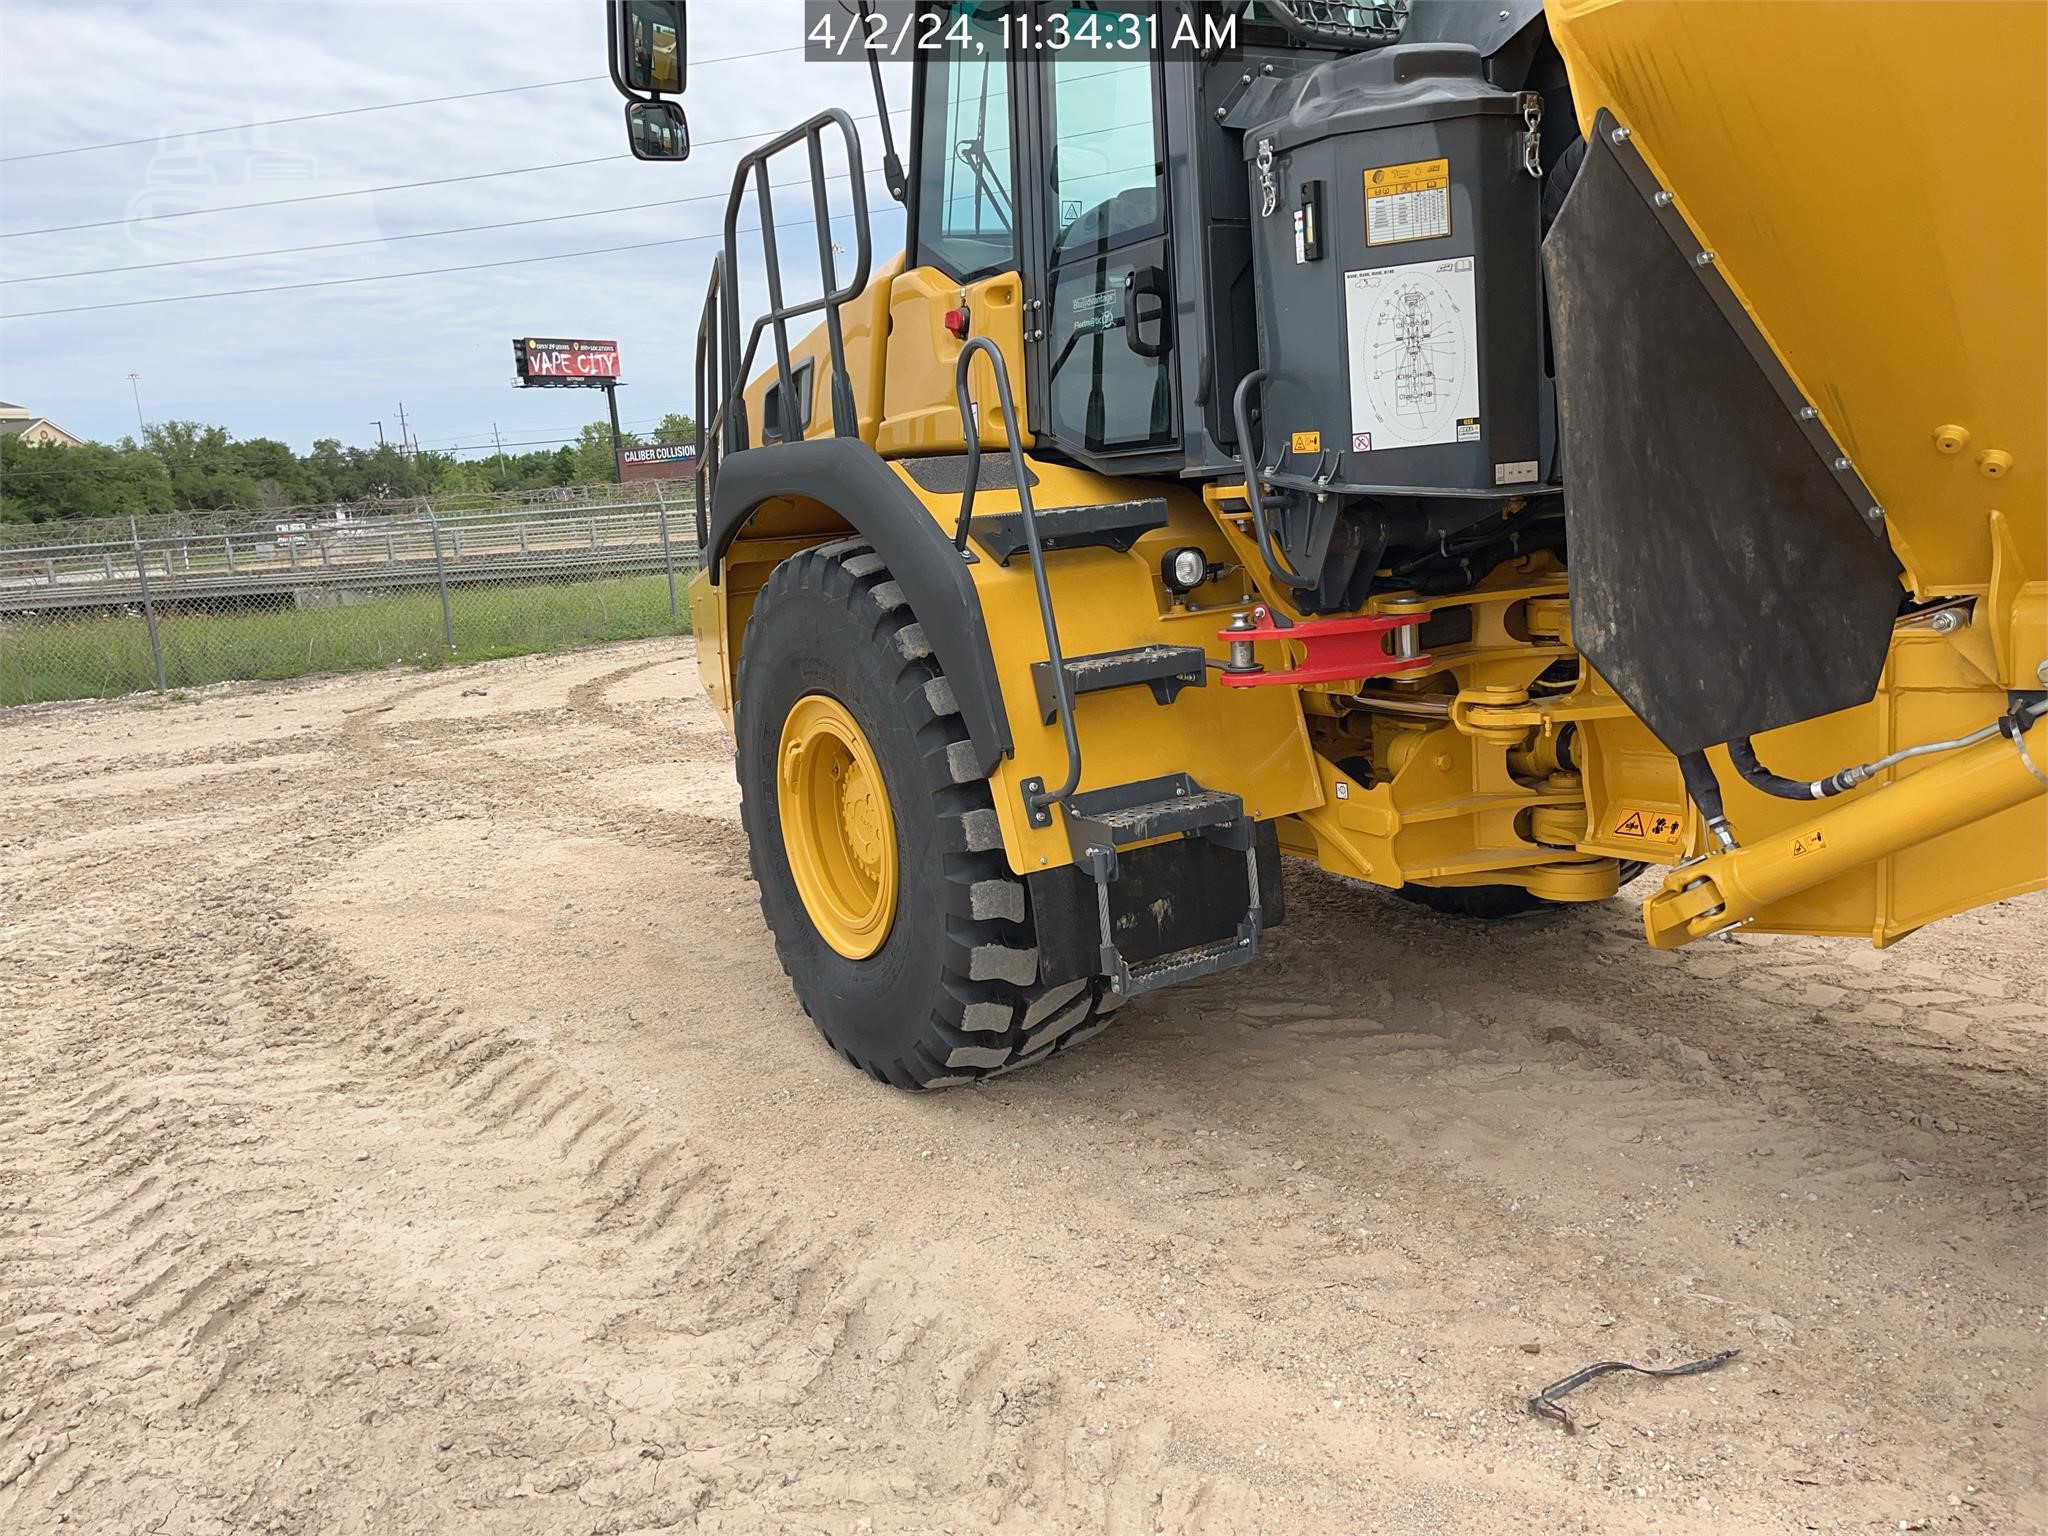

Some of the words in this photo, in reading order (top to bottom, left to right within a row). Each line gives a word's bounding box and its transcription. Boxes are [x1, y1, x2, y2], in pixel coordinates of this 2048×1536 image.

[530, 352, 573, 375] VAPE
[577, 352, 616, 375] CITY
[624, 449, 656, 462] CALIBER
[656, 445, 696, 459] COLLISION
